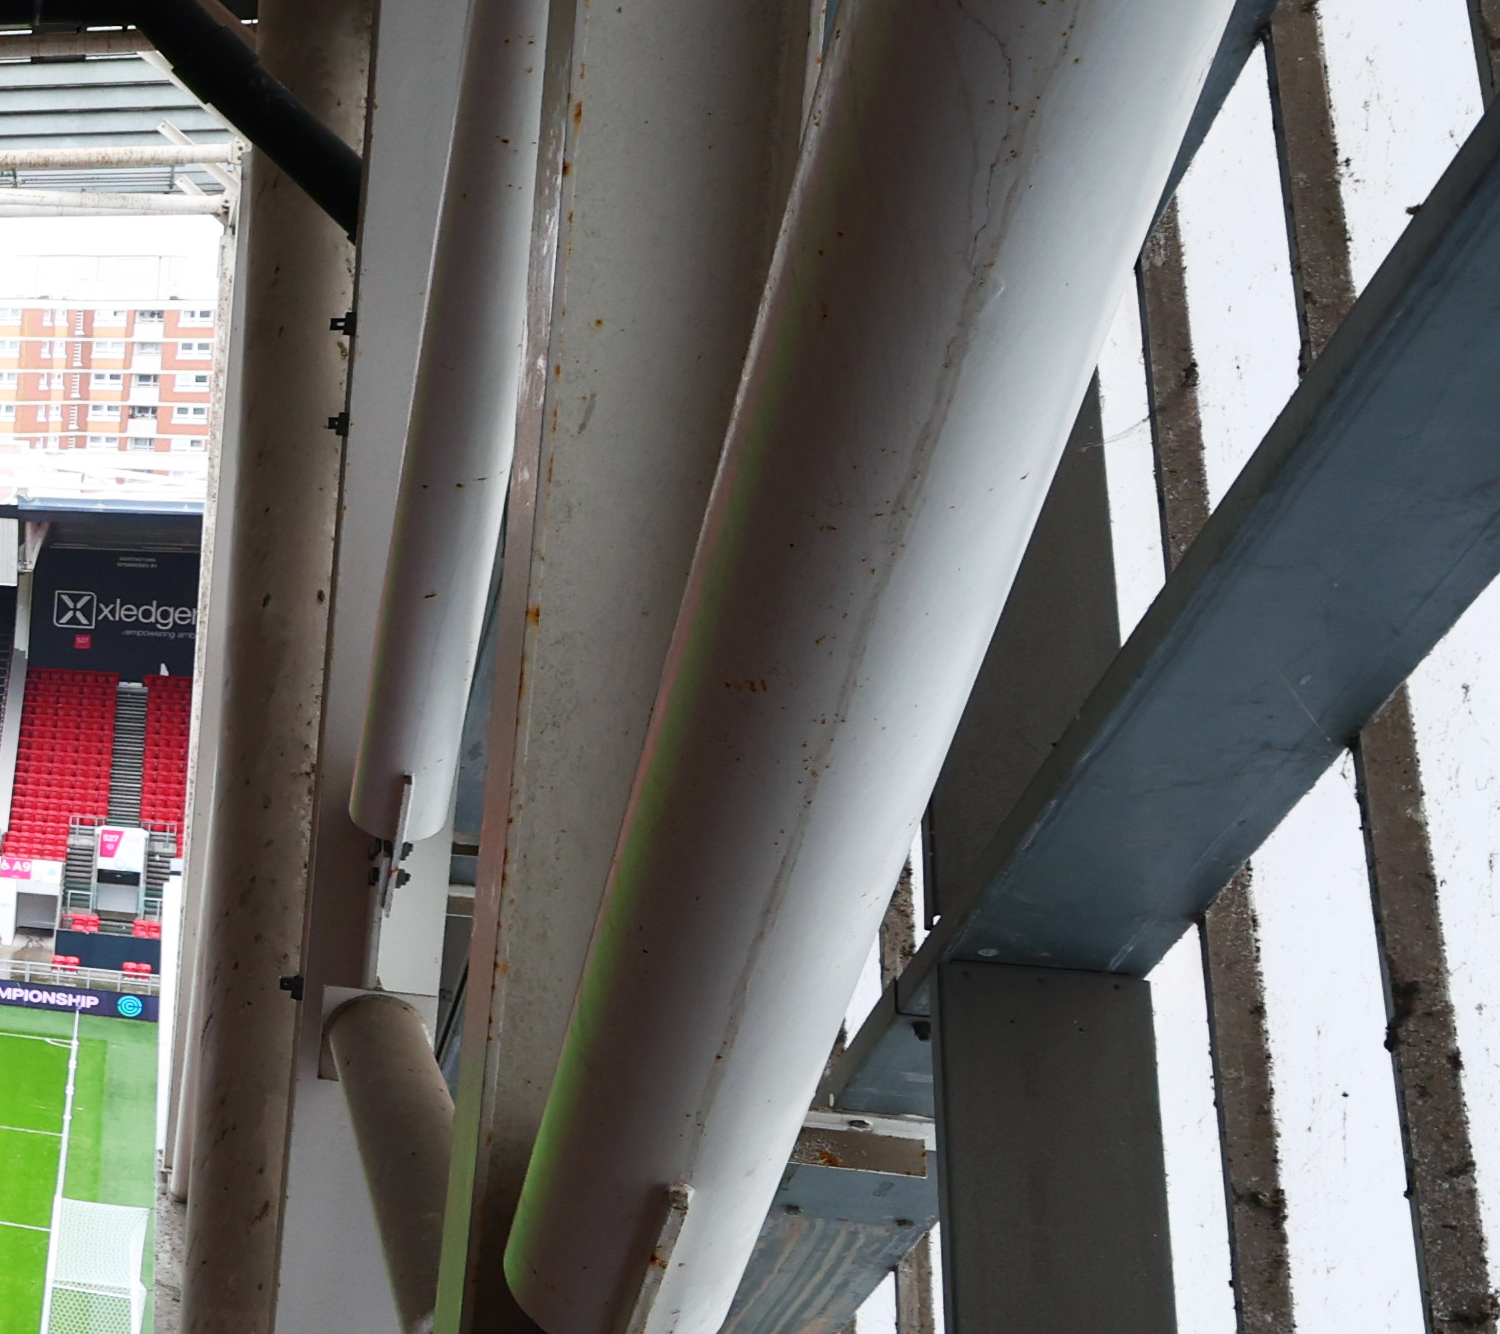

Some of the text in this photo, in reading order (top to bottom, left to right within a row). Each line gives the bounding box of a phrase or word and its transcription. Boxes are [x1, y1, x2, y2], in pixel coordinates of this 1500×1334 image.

[97, 598, 198, 630] xledger
[102, 834, 120, 842] S27
[13, 860, 31, 873] A9
